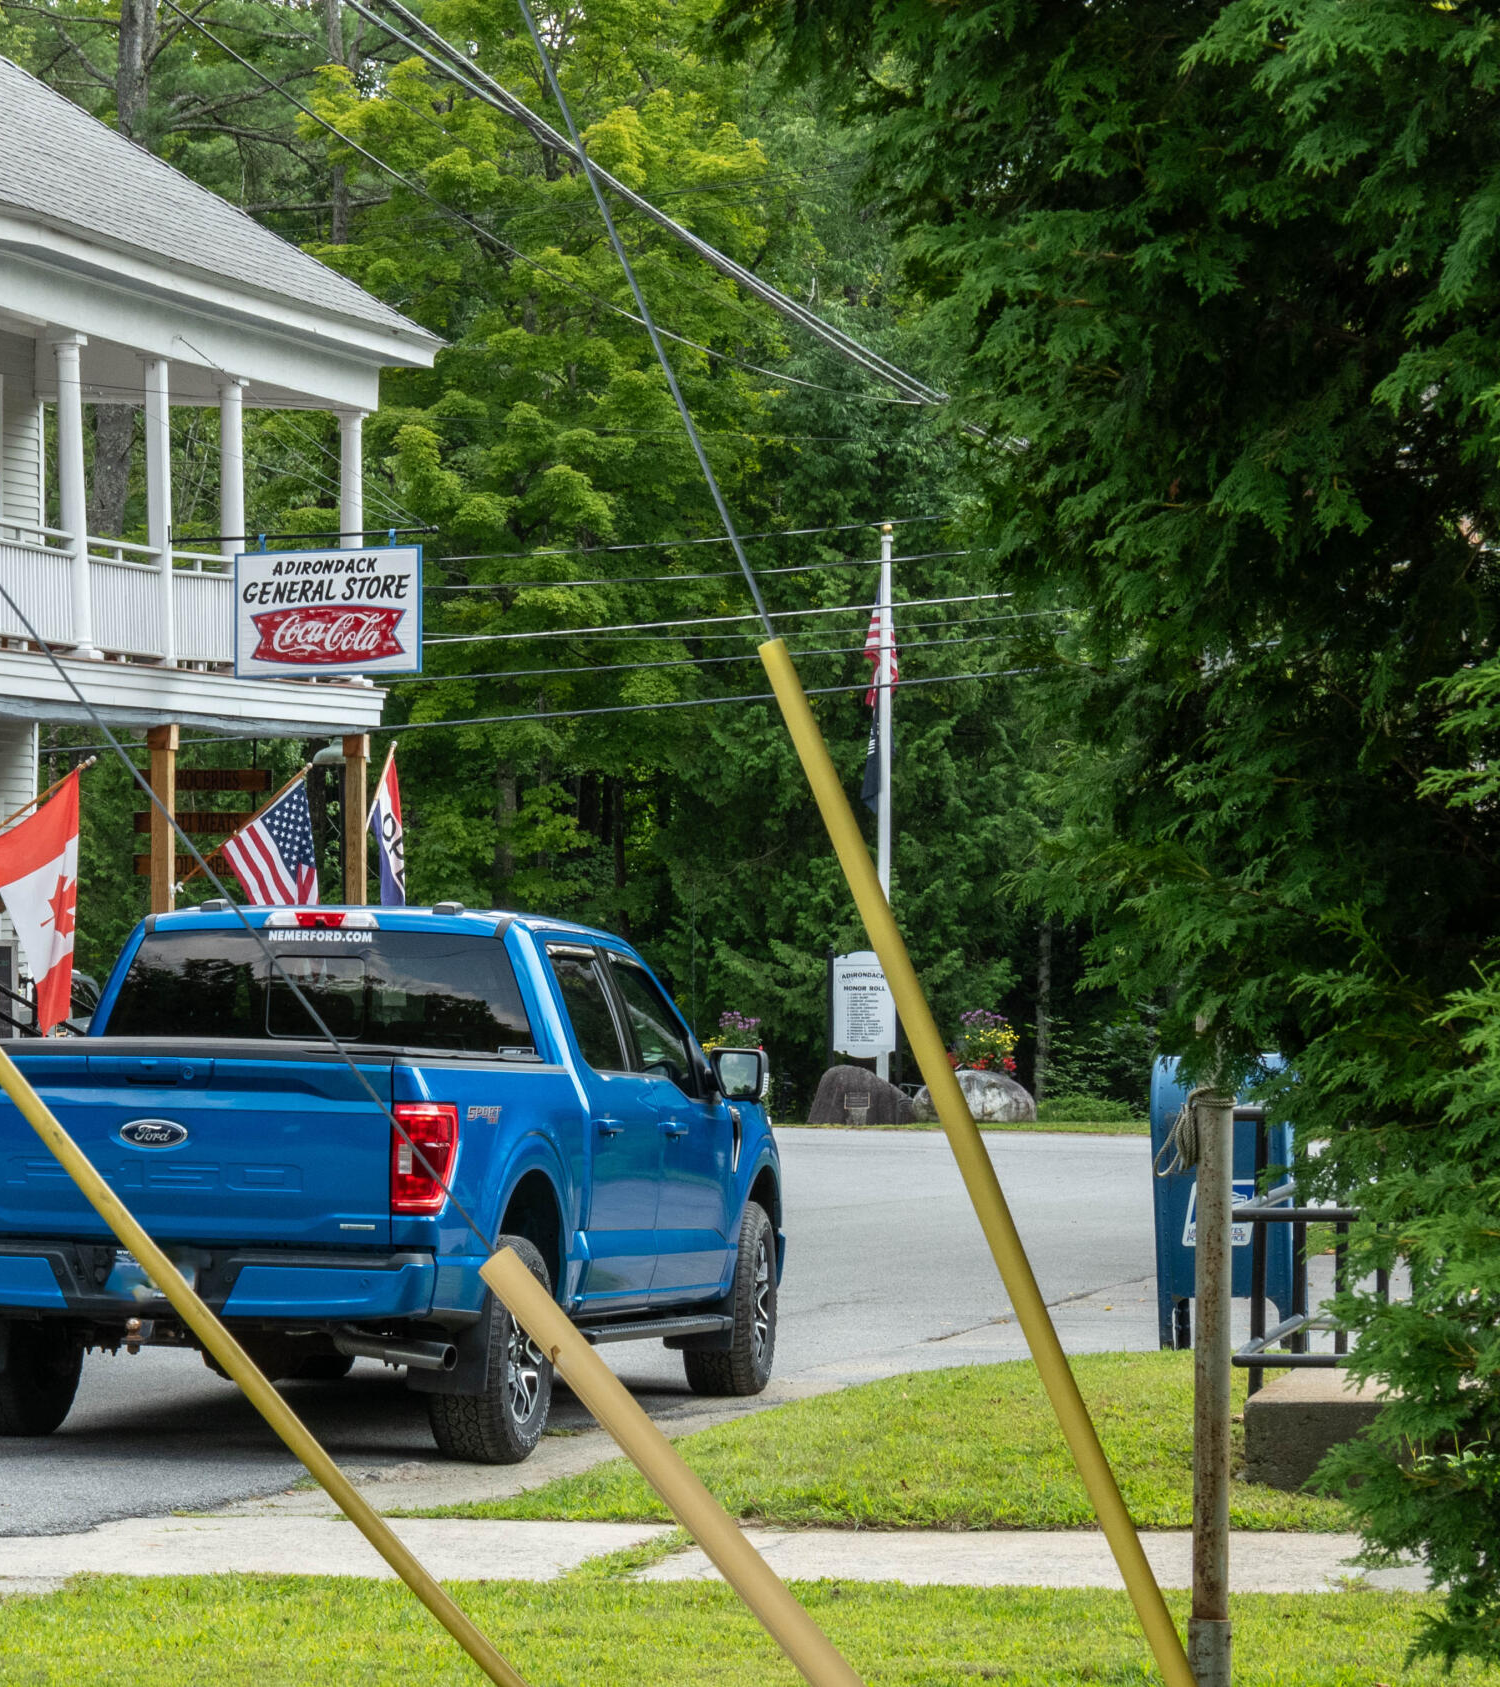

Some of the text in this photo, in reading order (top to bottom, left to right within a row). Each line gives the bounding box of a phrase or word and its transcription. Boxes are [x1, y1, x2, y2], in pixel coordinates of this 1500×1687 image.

[272, 557, 378, 576] ADIRONDACK
[242, 573, 411, 605] GENERAL STORE
[272, 612, 387, 654] Coca-Cola
[268, 929, 373, 943] NEMERFORD.COM
[841, 971, 885, 980] ADIRONDACK
[467, 1105, 503, 1121] SPORT
[133, 1124, 172, 1142] Ford
